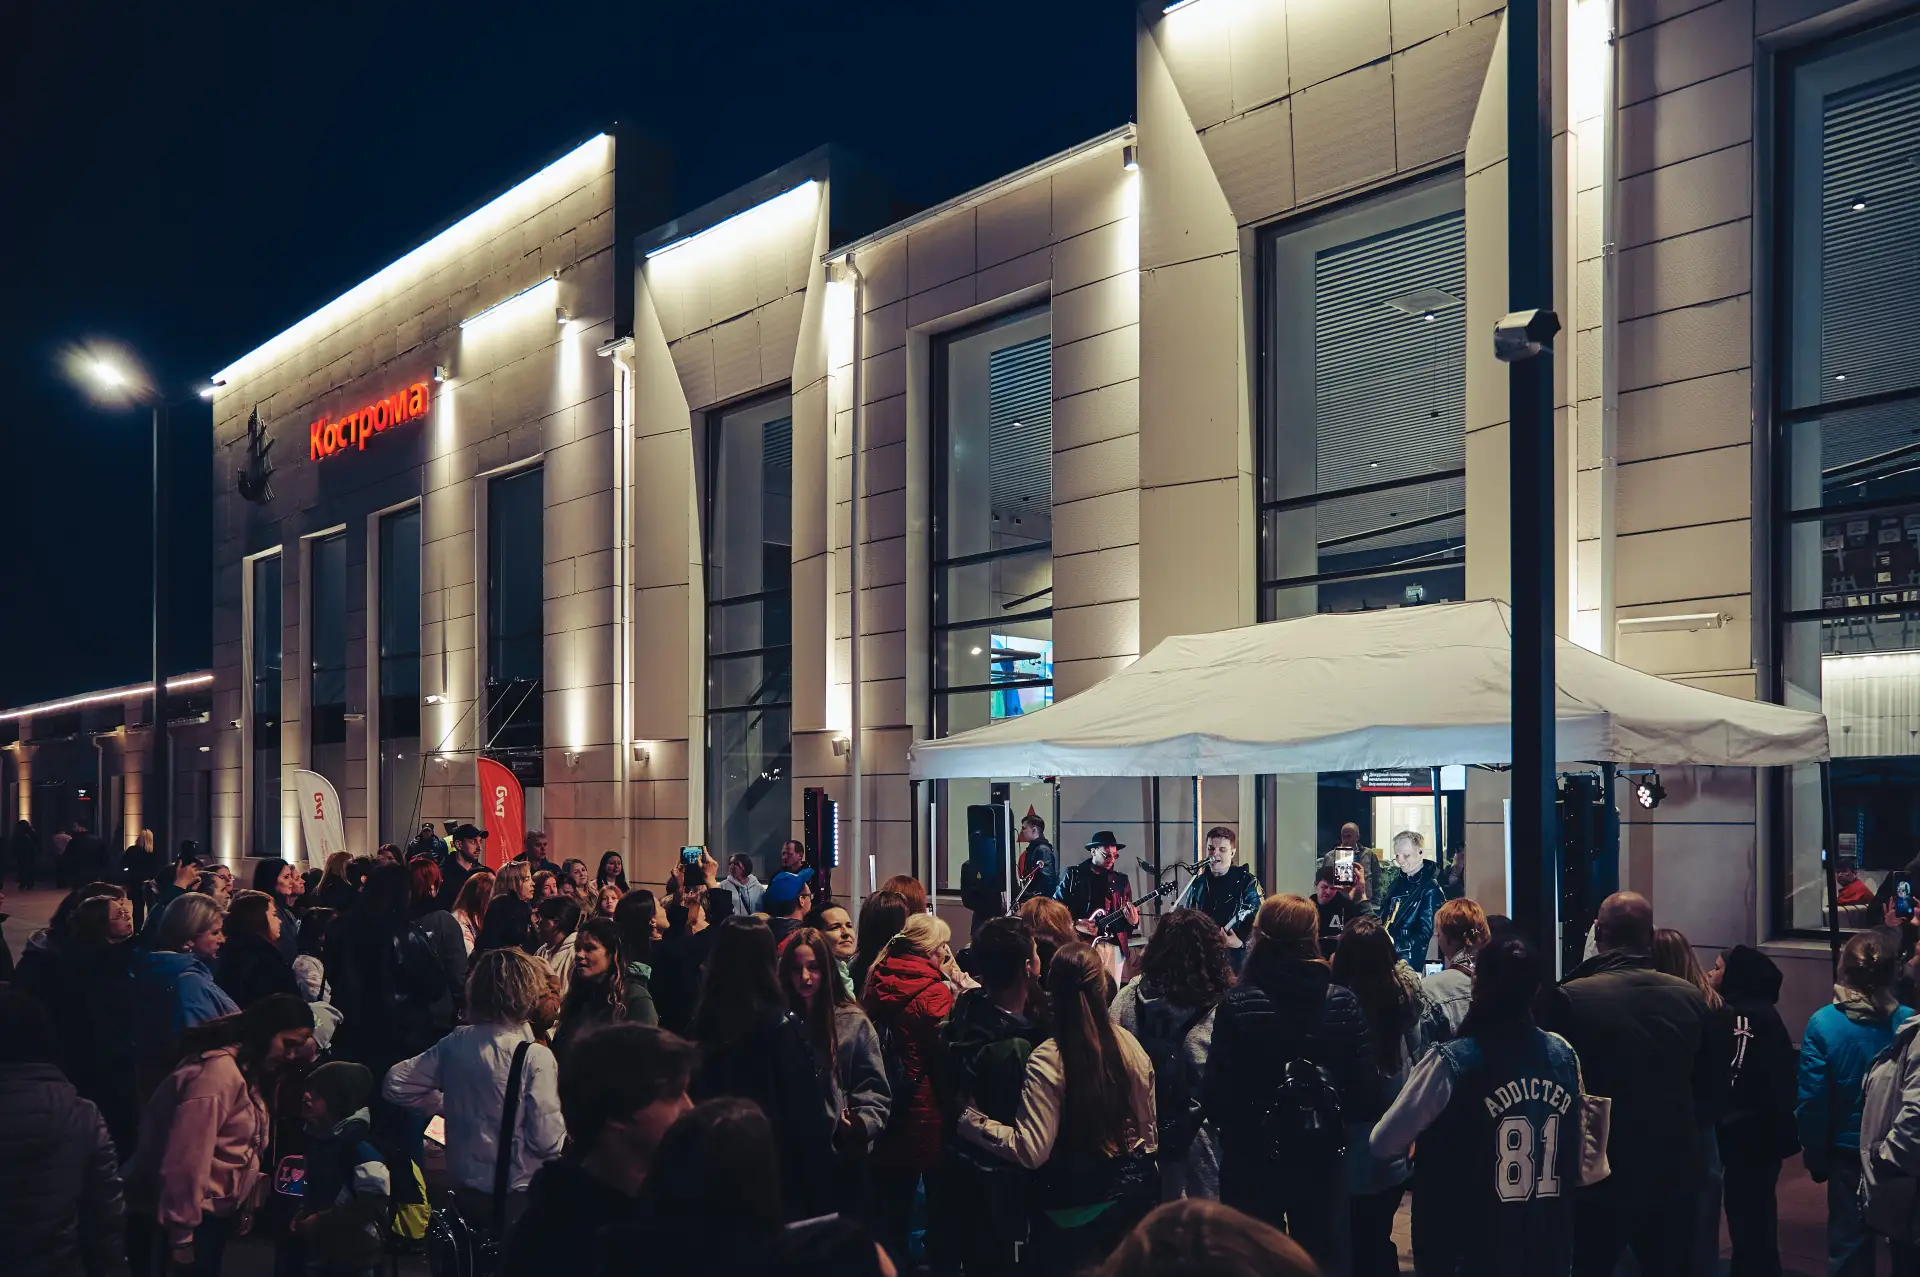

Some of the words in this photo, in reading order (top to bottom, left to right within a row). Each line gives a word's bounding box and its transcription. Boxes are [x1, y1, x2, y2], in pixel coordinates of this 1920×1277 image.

[310, 383, 428, 460] Кострома
[1484, 1078, 1571, 1118] ADDICTED
[1495, 1114, 1560, 1202] 81
